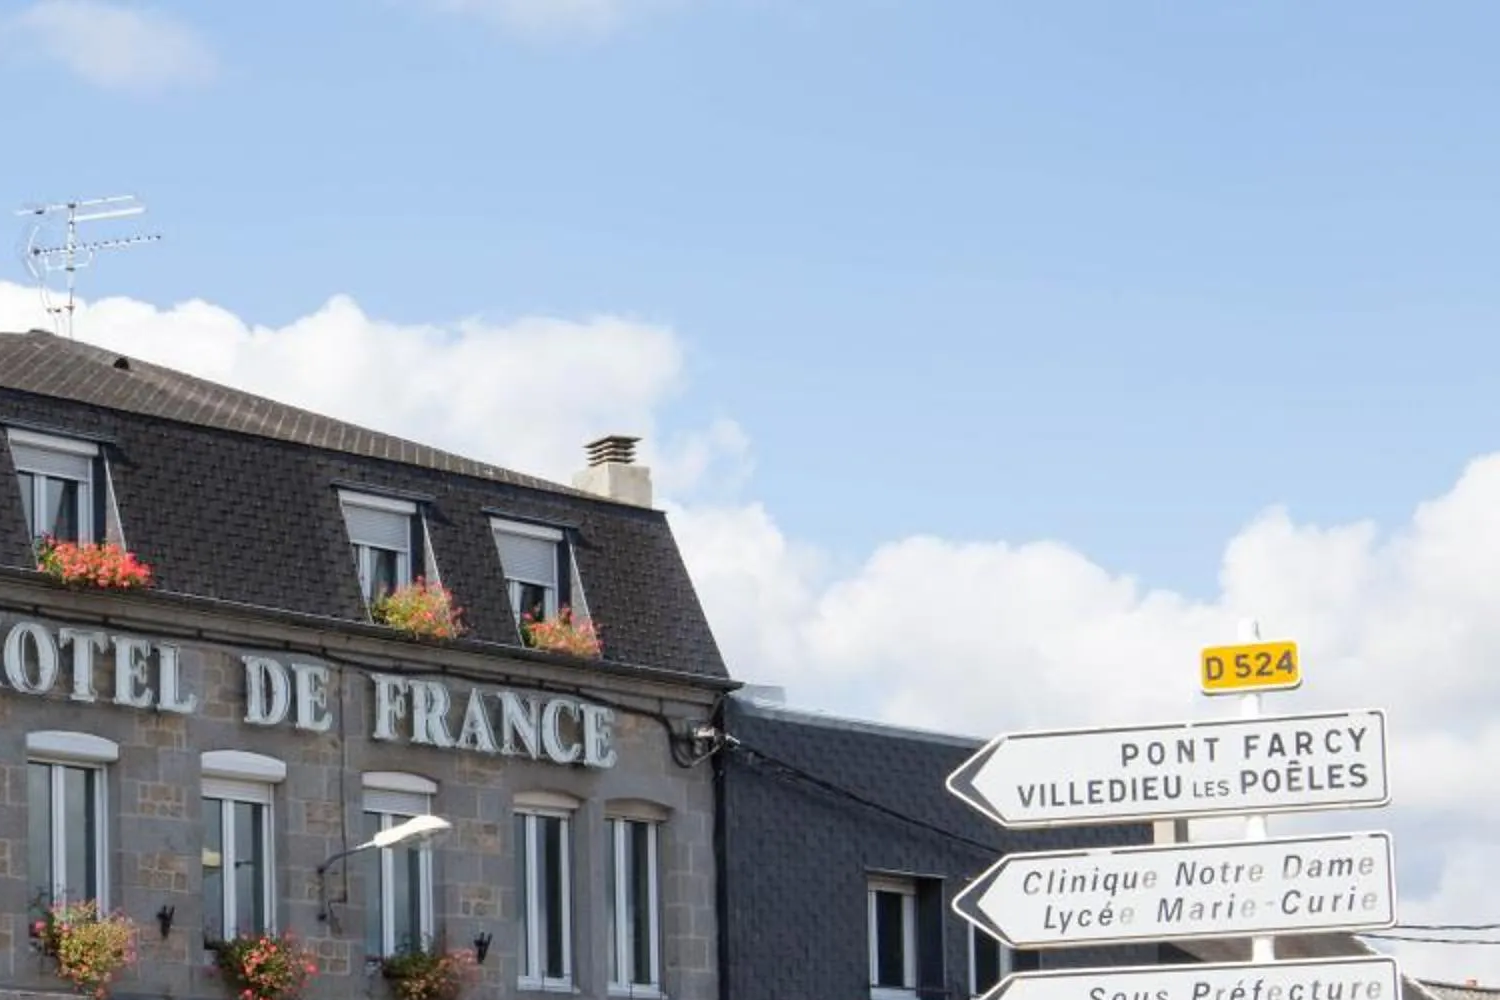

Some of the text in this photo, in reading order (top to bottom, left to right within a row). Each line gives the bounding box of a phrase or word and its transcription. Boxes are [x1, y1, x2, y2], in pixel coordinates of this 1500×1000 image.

[1205, 650, 1296, 681] D 524
[241, 654, 332, 732] DE
[371, 671, 619, 769] FRANCE
[1120, 727, 1367, 767] PONT FARCY
[1017, 760, 1369, 808] VILLEDIEU LES POÊLES
[1023, 853, 1375, 897] Clinique Notre Dame
[1044, 901, 1135, 935] Lycée
